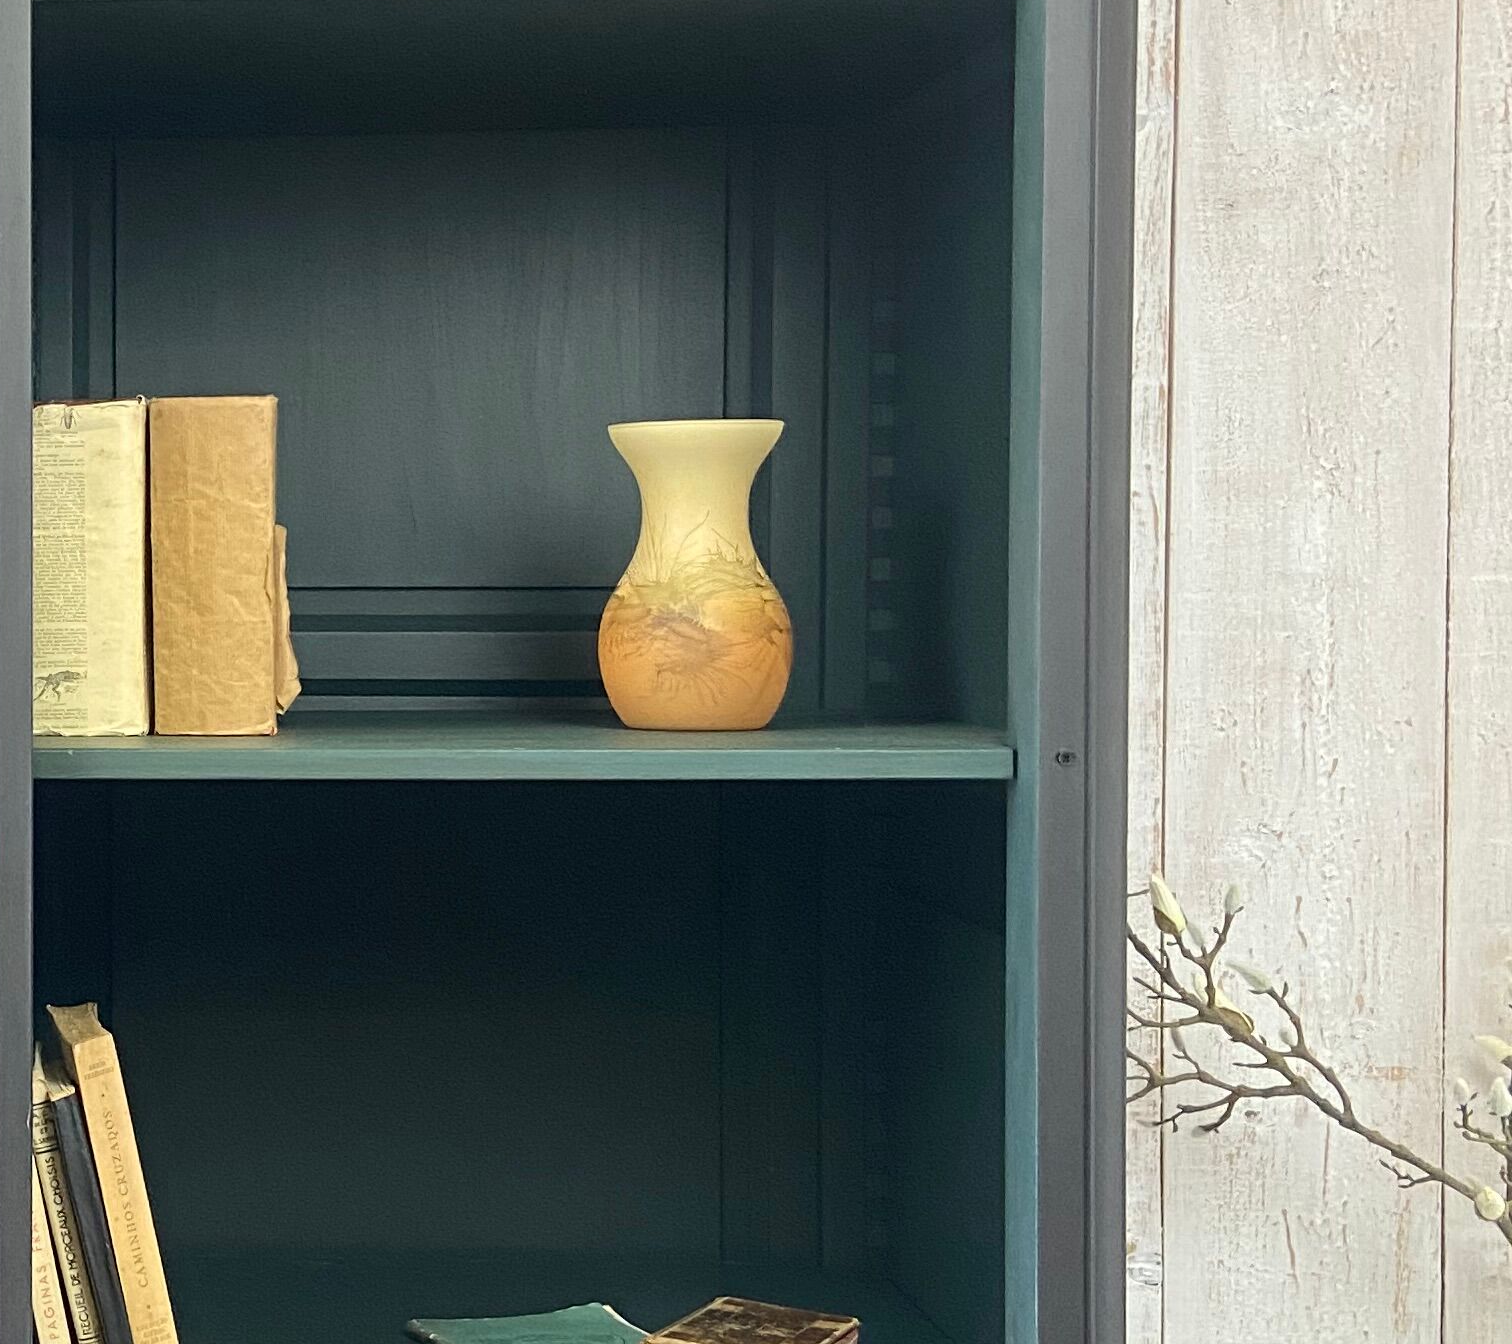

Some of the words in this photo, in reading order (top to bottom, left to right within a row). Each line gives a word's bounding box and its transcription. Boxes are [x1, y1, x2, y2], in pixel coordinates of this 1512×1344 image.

[44, 1156, 64, 1206] CHOISIS
[102, 1110, 129, 1197] CRUZADOS
[56, 1208, 78, 1271] MORCEAUX
[122, 1201, 149, 1289] CAMINHOS
[71, 1274, 82, 1287] DE
[74, 1289, 91, 1336] RECUEIL
